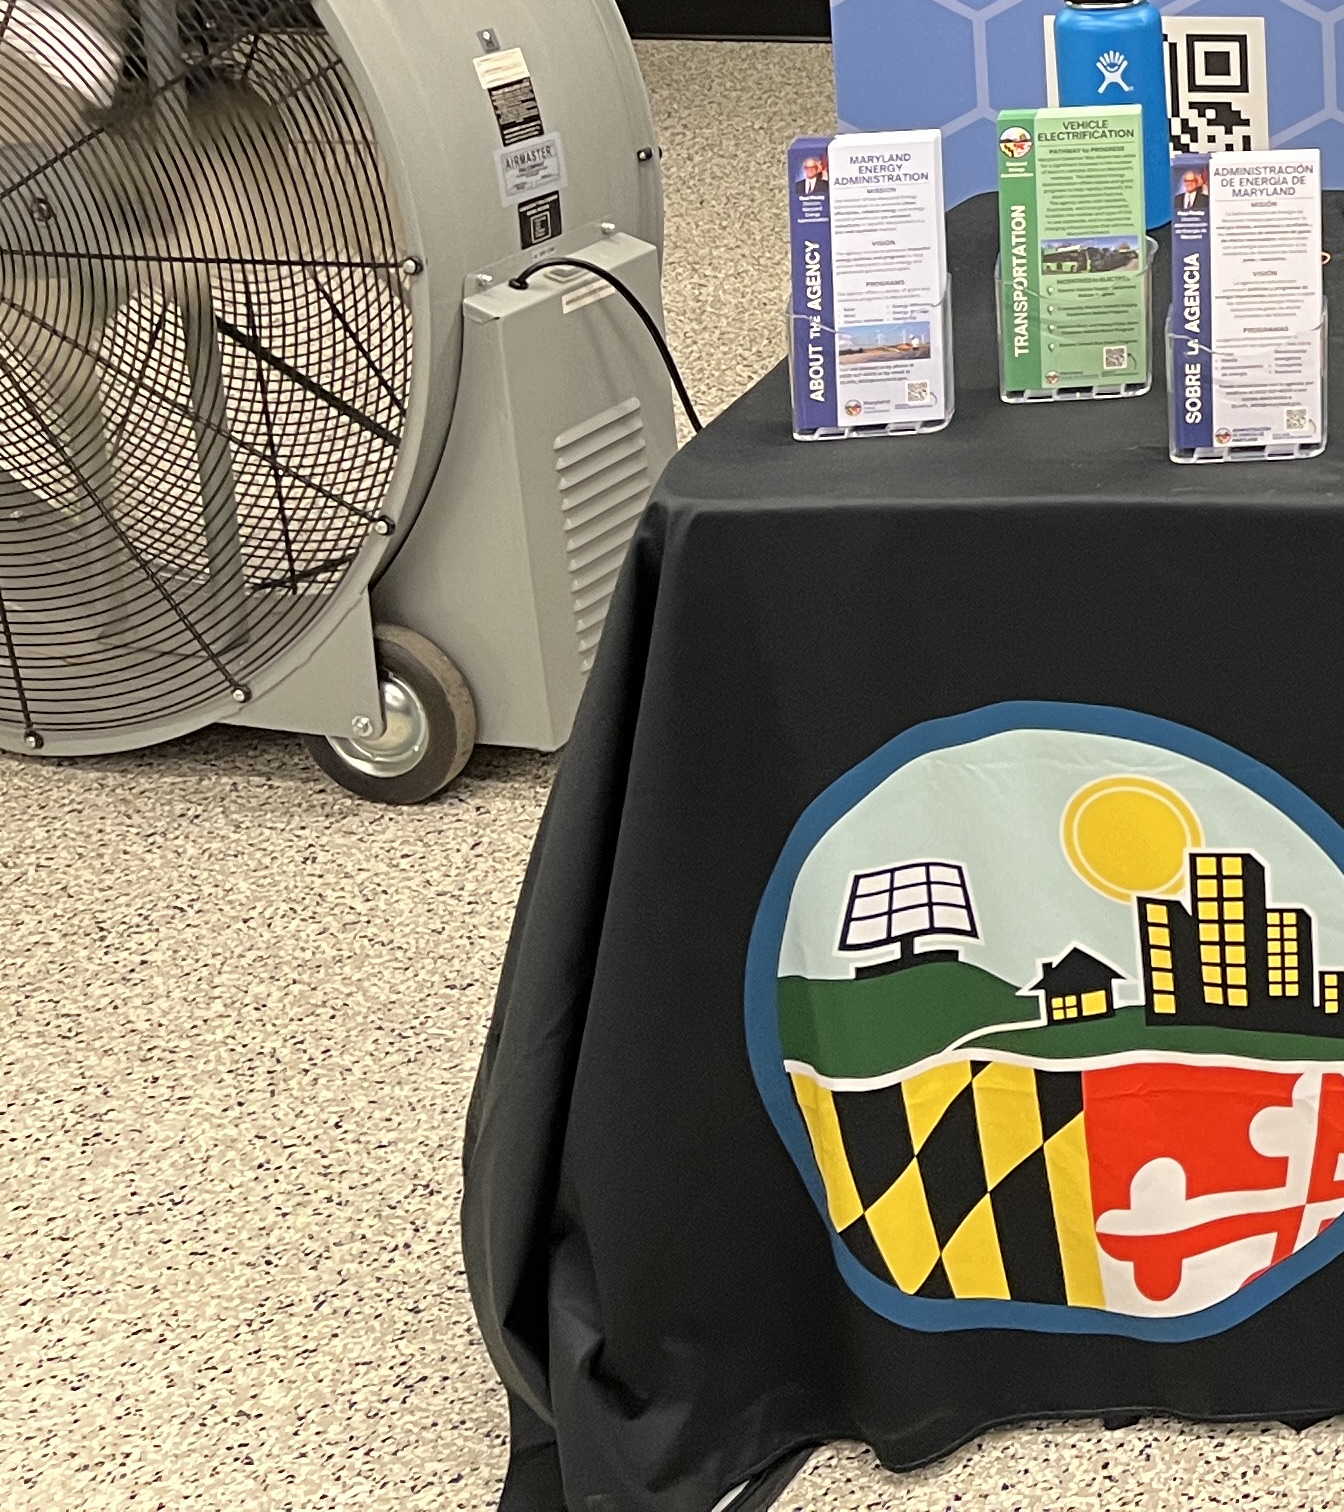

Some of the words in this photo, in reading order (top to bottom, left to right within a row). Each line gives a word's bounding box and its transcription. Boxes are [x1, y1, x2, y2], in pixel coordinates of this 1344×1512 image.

[1062, 119, 1109, 130] VEHICLE
[1037, 129, 1135, 142] ELECTRIFICATION
[505, 145, 552, 170] AIRMASTER
[849, 153, 912, 165] MARYLAND
[858, 164, 903, 175] ENERGY
[1213, 163, 1314, 177] ADMINISTRACIÓN
[833, 172, 929, 186] ADMINISTRATION
[1220, 177, 1235, 187] DE
[1238, 175, 1289, 186] ENERGÍA
[1291, 175, 1306, 185] DE
[1231, 186, 1296, 197] MARYLAND
[804, 240, 823, 311] AGENCY
[1010, 205, 1030, 358] TRANSPORTATION
[1183, 252, 1201, 333] AGENCIA
[809, 315, 822, 339] THE
[1186, 338, 1200, 356] LA
[808, 343, 825, 402] ABOUT
[1184, 363, 1202, 424] SOBRE
